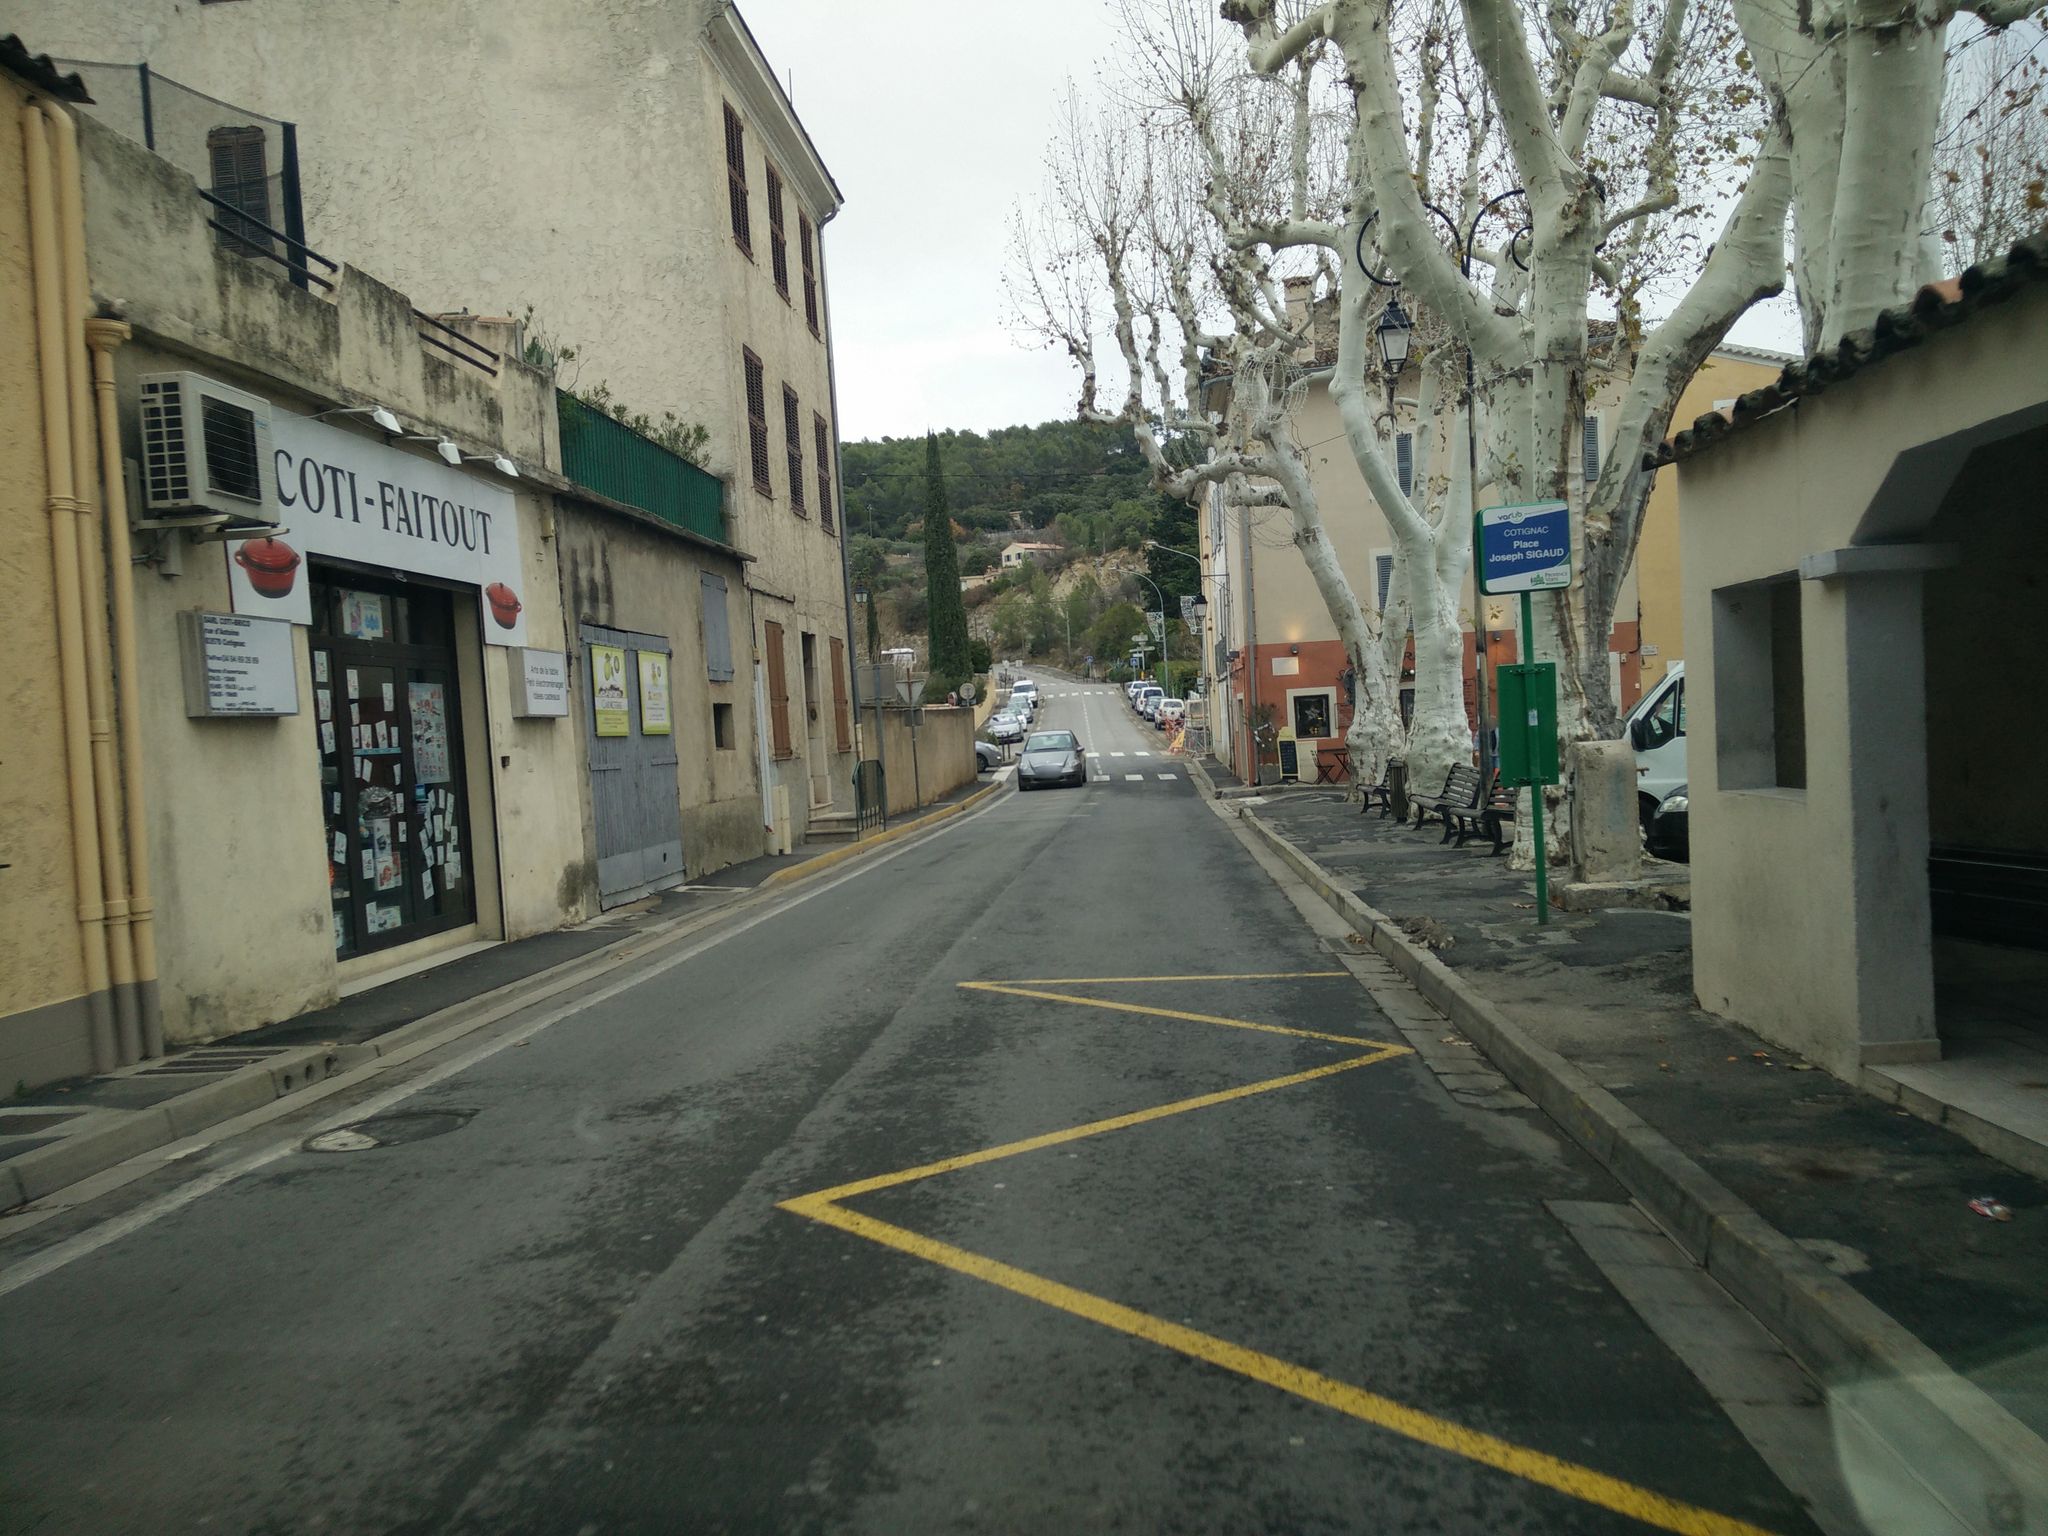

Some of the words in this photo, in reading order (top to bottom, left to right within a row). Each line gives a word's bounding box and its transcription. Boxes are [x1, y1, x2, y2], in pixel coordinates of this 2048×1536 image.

[275, 449, 492, 555] COTI-FAITOUT
[1503, 526, 1549, 537] COTIGNAC
[1513, 540, 1540, 550] Place
[1489, 551, 1524, 562] Joseph
[1525, 548, 1564, 559] SIGAUD
[539, 667, 545, 675] de
